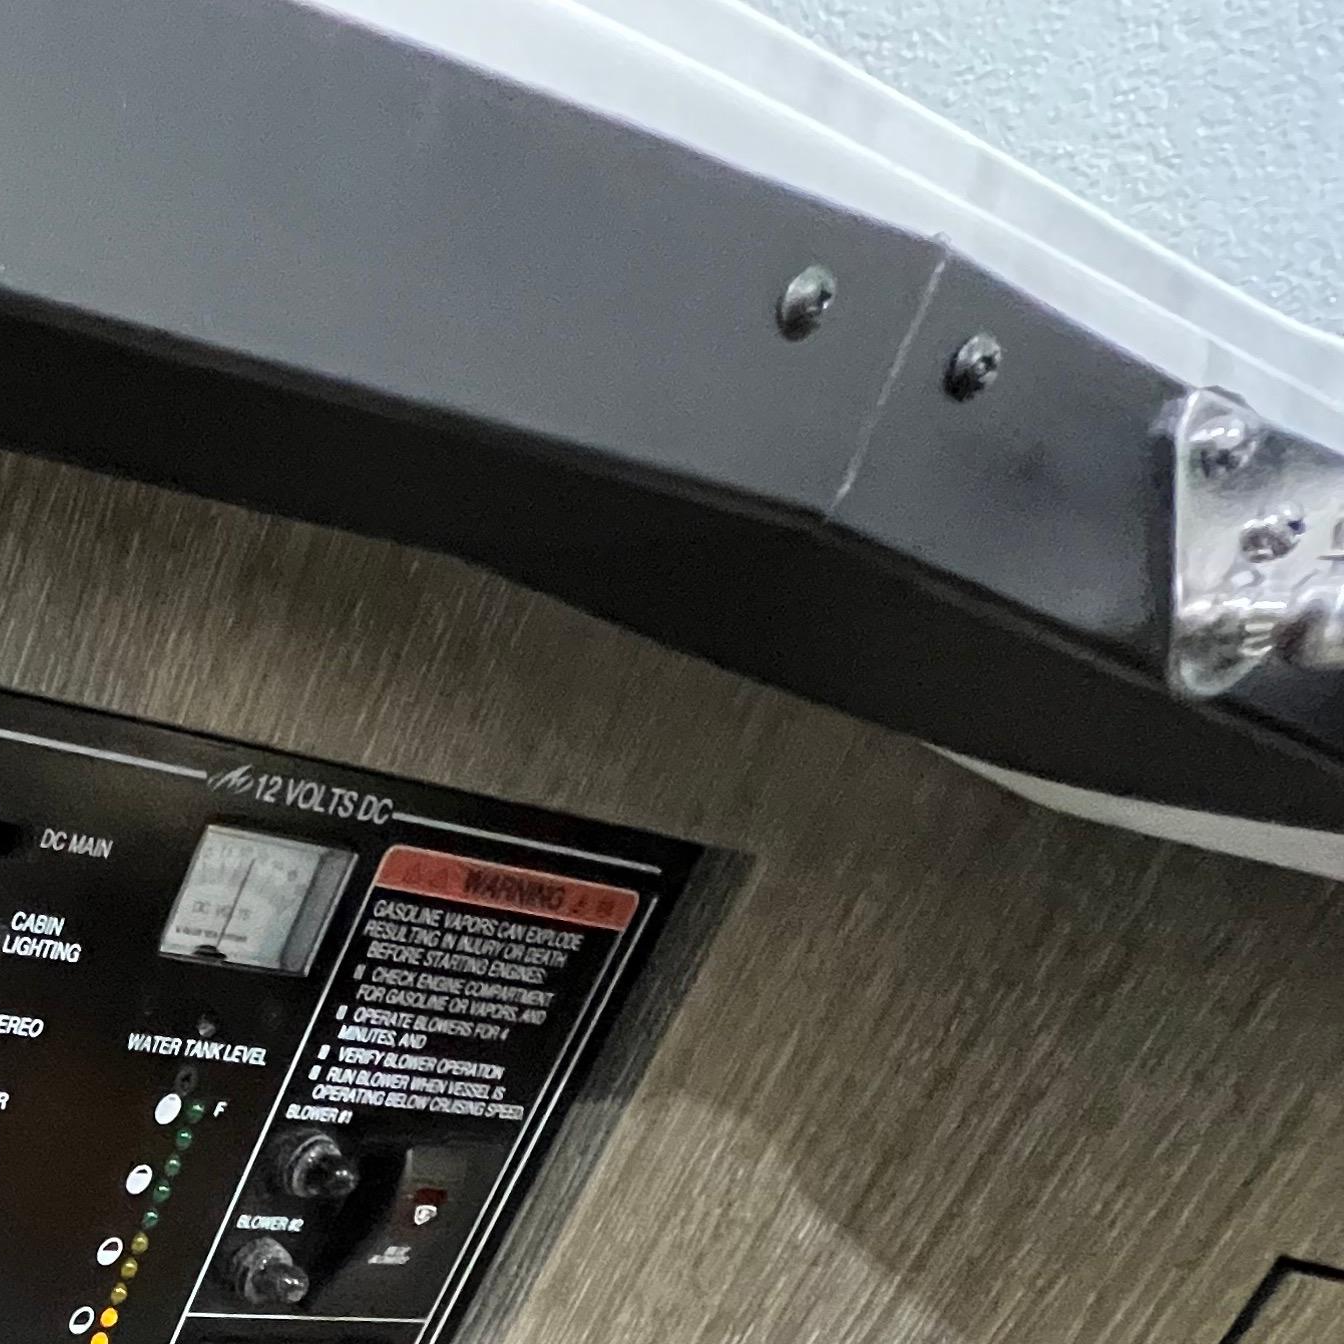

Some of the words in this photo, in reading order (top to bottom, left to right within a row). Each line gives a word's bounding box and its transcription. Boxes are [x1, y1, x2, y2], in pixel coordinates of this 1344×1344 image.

[256, 775, 282, 803] 12
[286, 778, 359, 818] VOLTS
[357, 794, 393, 824] DC
[40, 829, 68, 851] DC
[68, 832, 113, 858] MAIN
[11, 911, 65, 936] CABIN
[363, 920, 441, 947] RESULTING
[373, 900, 443, 927] GASOLINE
[444, 911, 499, 936] VAPORS
[526, 926, 584, 951] EXPLODE
[3, 935, 82, 962] LIGHTING
[366, 941, 423, 966] BEFORE
[423, 950, 488, 974] STARTING
[372, 966, 416, 987] CHECK
[416, 973, 462, 994] ENGINE
[356, 984, 386, 1001] FOR
[386, 989, 449, 1011] GASOLINE
[353, 1006, 413, 1028] OPERATE
[414, 1013, 474, 1036] BLOWERS
[128, 1033, 182, 1056] WATER
[184, 1039, 225, 1060] TANK
[223, 1044, 266, 1066] LEVEL
[399, 1033, 427, 1049] AND
[338, 1046, 384, 1065] VERIFY
[384, 1051, 437, 1071] BLOWER
[326, 1067, 356, 1085] RUN
[356, 1070, 410, 1090] BLOWER
[213, 1101, 227, 1118] F
[312, 1084, 384, 1106] OPERATING
[385, 1091, 429, 1110] BELOW
[286, 1103, 338, 1123] BLOWER
[236, 1214, 288, 1230] BLOWER
